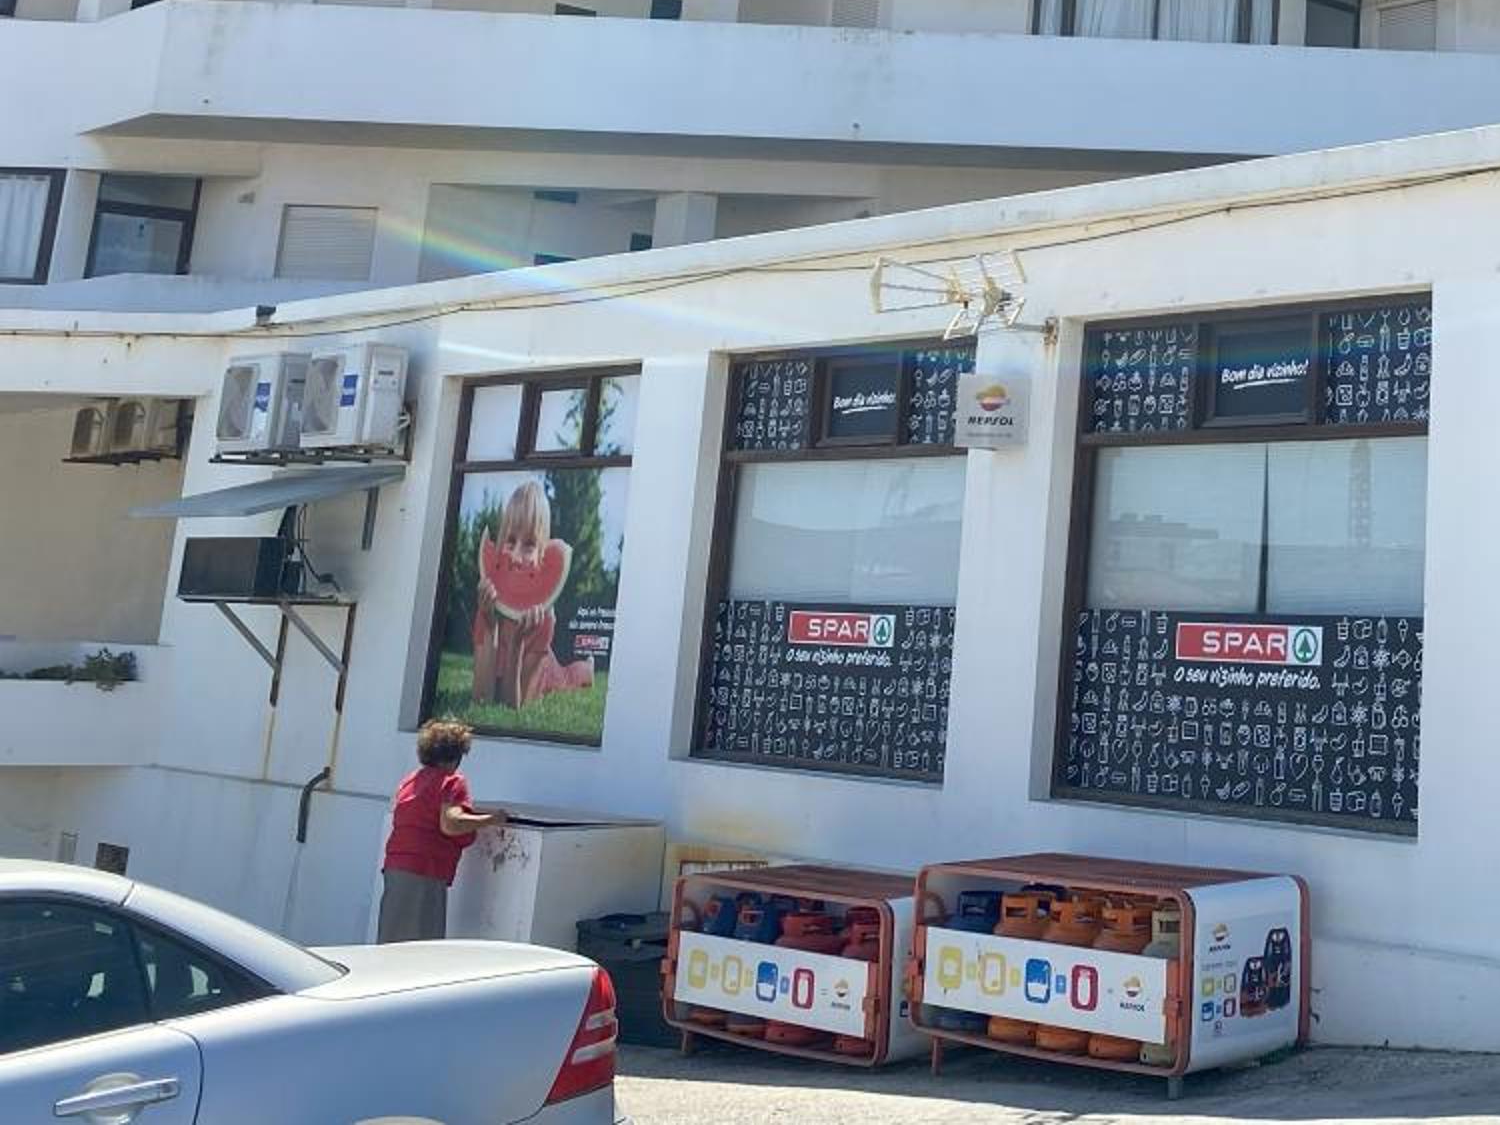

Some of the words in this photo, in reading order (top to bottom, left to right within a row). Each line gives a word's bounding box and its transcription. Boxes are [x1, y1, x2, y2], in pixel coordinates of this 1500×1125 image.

[1221, 368, 1247, 383] Bom
[967, 416, 1015, 426] REPSOL
[808, 618, 869, 639] SPAR
[1202, 630, 1287, 656] SPAR
[1173, 666, 1185, 682] O
[1185, 666, 1209, 682] seu
[1255, 668, 1322, 690] preferido.
